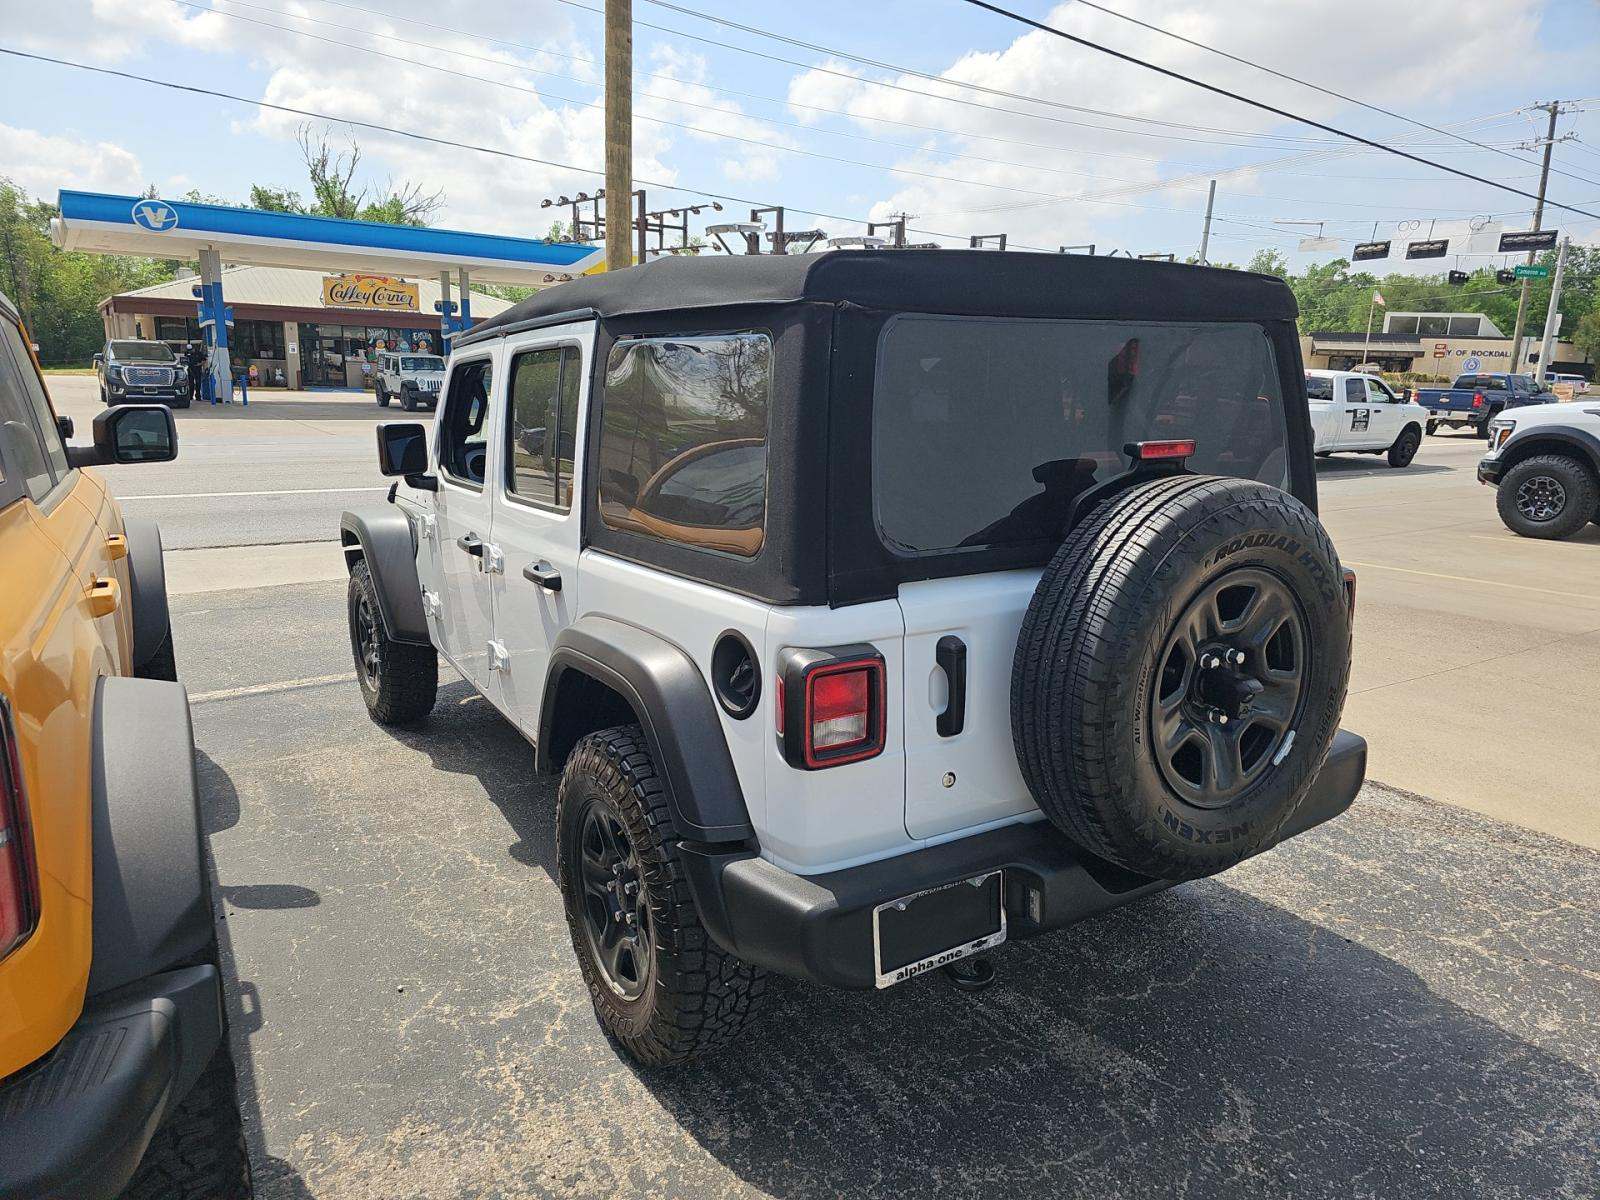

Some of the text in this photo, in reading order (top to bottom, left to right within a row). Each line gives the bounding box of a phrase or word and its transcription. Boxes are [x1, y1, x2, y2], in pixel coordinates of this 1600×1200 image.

[372, 286, 414, 308] Corner
[1456, 349, 1468, 357] OF
[1213, 533, 1301, 564] ROADIAN
[1163, 809, 1250, 844] NEXEN
[896, 948, 963, 981] alpha one
